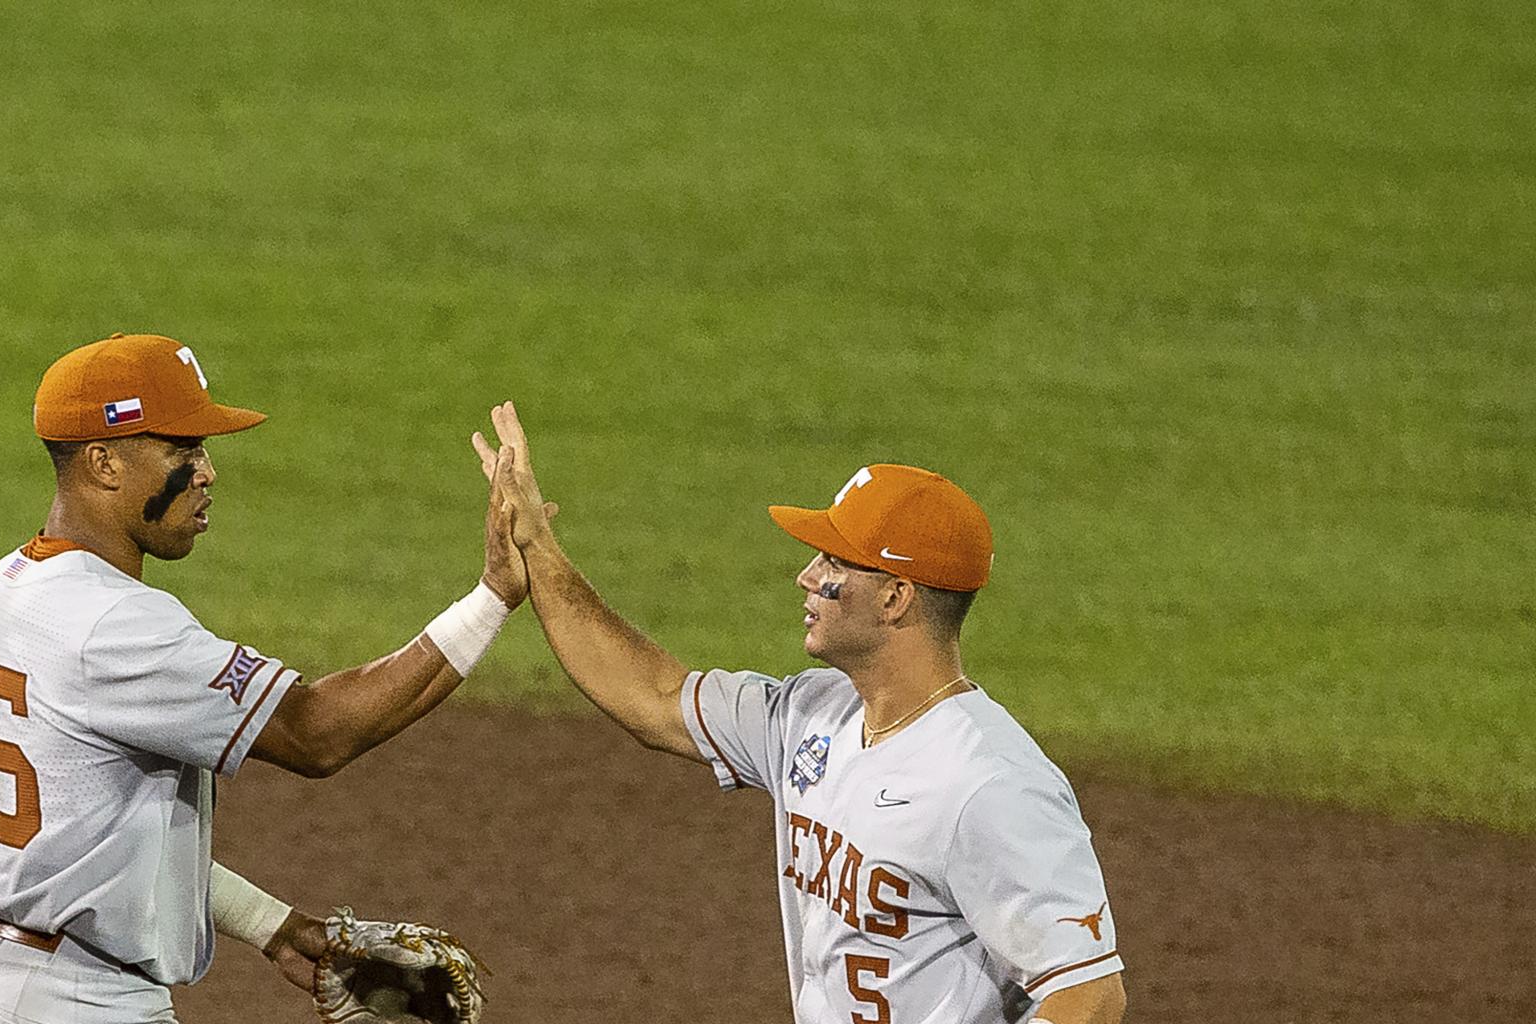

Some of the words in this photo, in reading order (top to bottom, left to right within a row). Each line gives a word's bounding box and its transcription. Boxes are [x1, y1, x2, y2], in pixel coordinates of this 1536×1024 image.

[176, 346, 208, 390] T
[834, 466, 872, 506] T
[783, 811, 911, 940] EXAS
